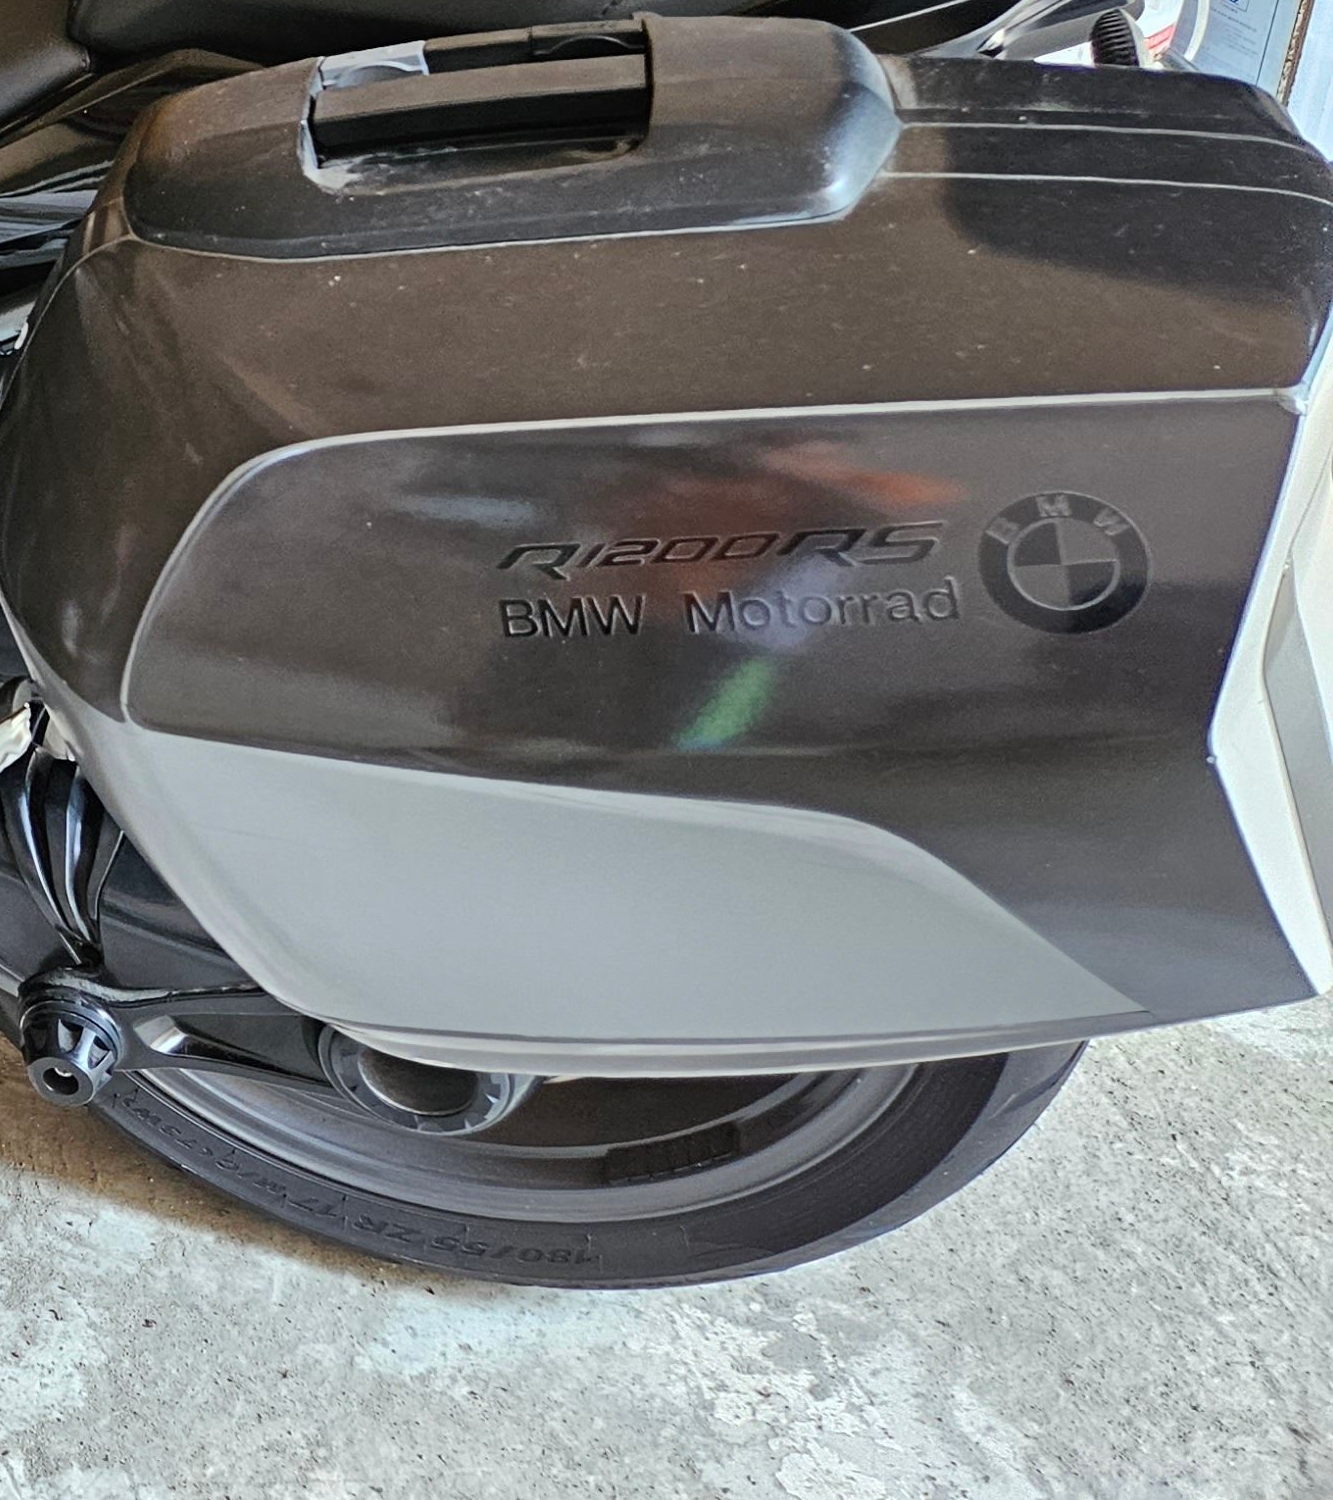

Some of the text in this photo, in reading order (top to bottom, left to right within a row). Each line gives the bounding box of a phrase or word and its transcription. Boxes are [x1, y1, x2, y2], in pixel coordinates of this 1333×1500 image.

[496, 519, 943, 581] R1200RS
[500, 575, 964, 641] BMW Motorrad
